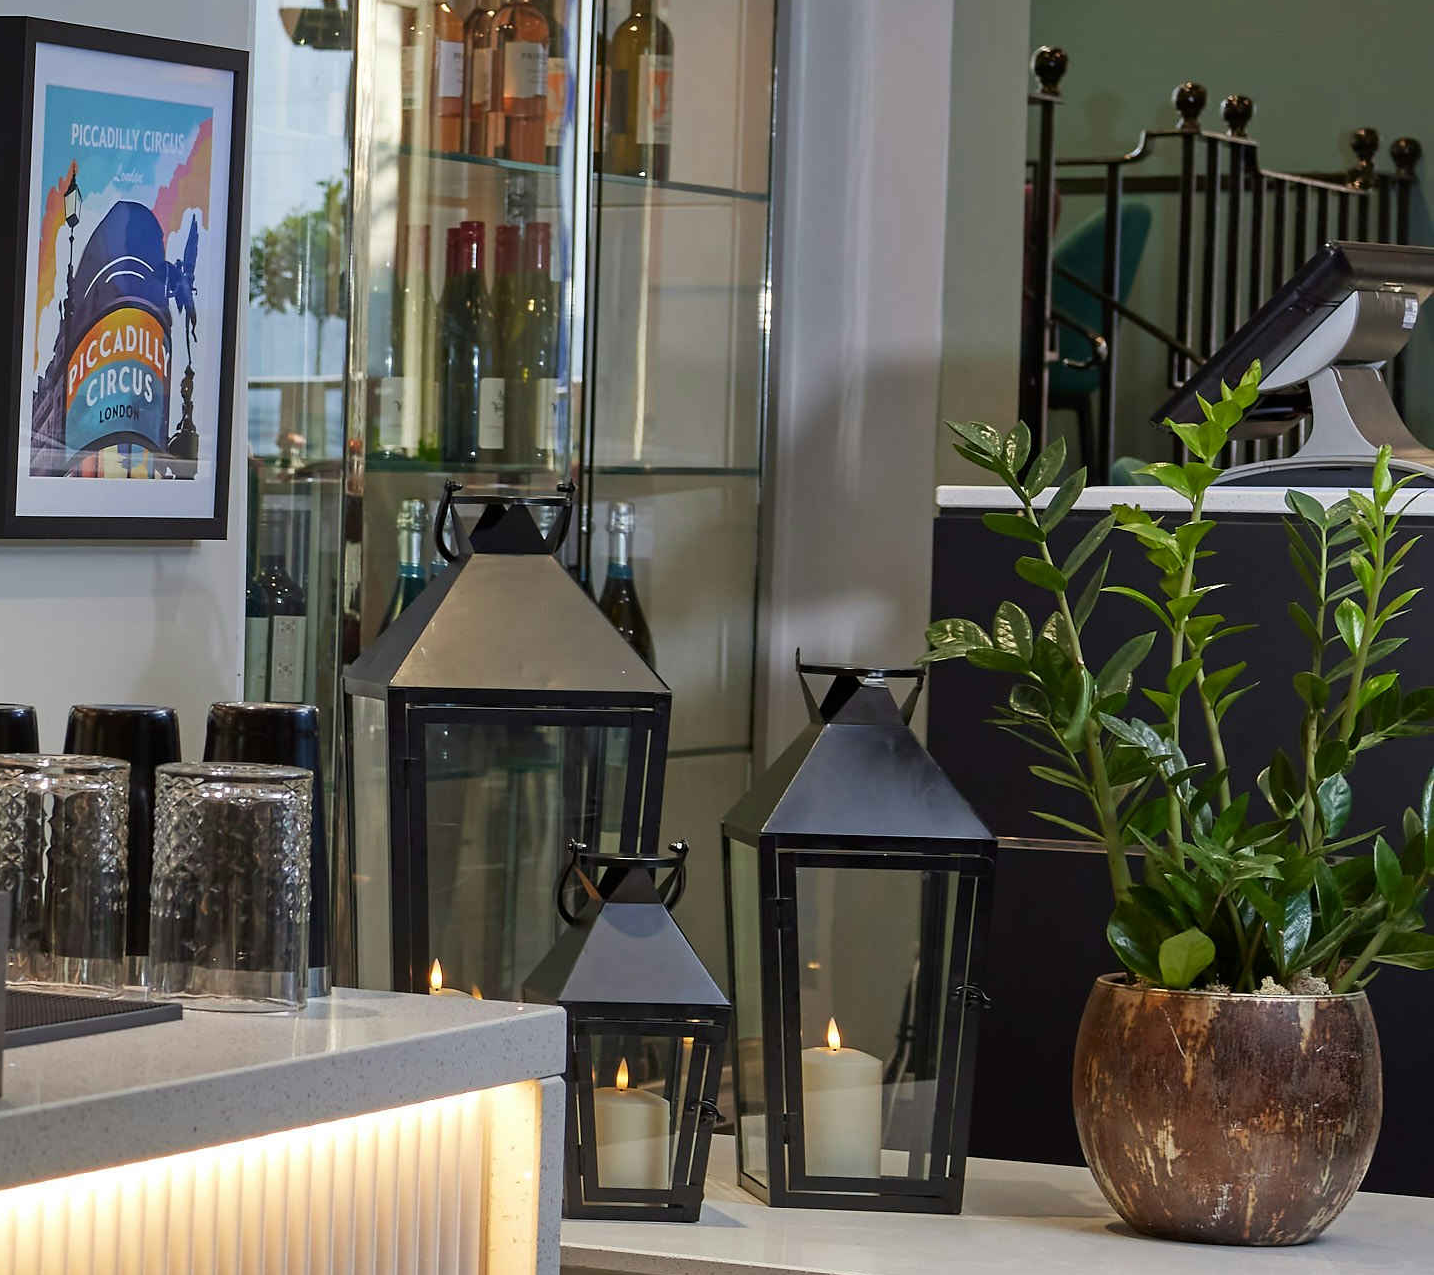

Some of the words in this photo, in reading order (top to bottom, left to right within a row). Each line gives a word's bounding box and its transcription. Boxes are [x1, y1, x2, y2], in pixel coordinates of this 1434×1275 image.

[71, 122, 139, 152] PICCADILLY
[143, 128, 185, 155] CIRCUS
[112, 163, 144, 184] London
[68, 325, 170, 397] PICCADILLY
[86, 366, 153, 407] CIRCUS
[99, 404, 140, 424] LONDON
